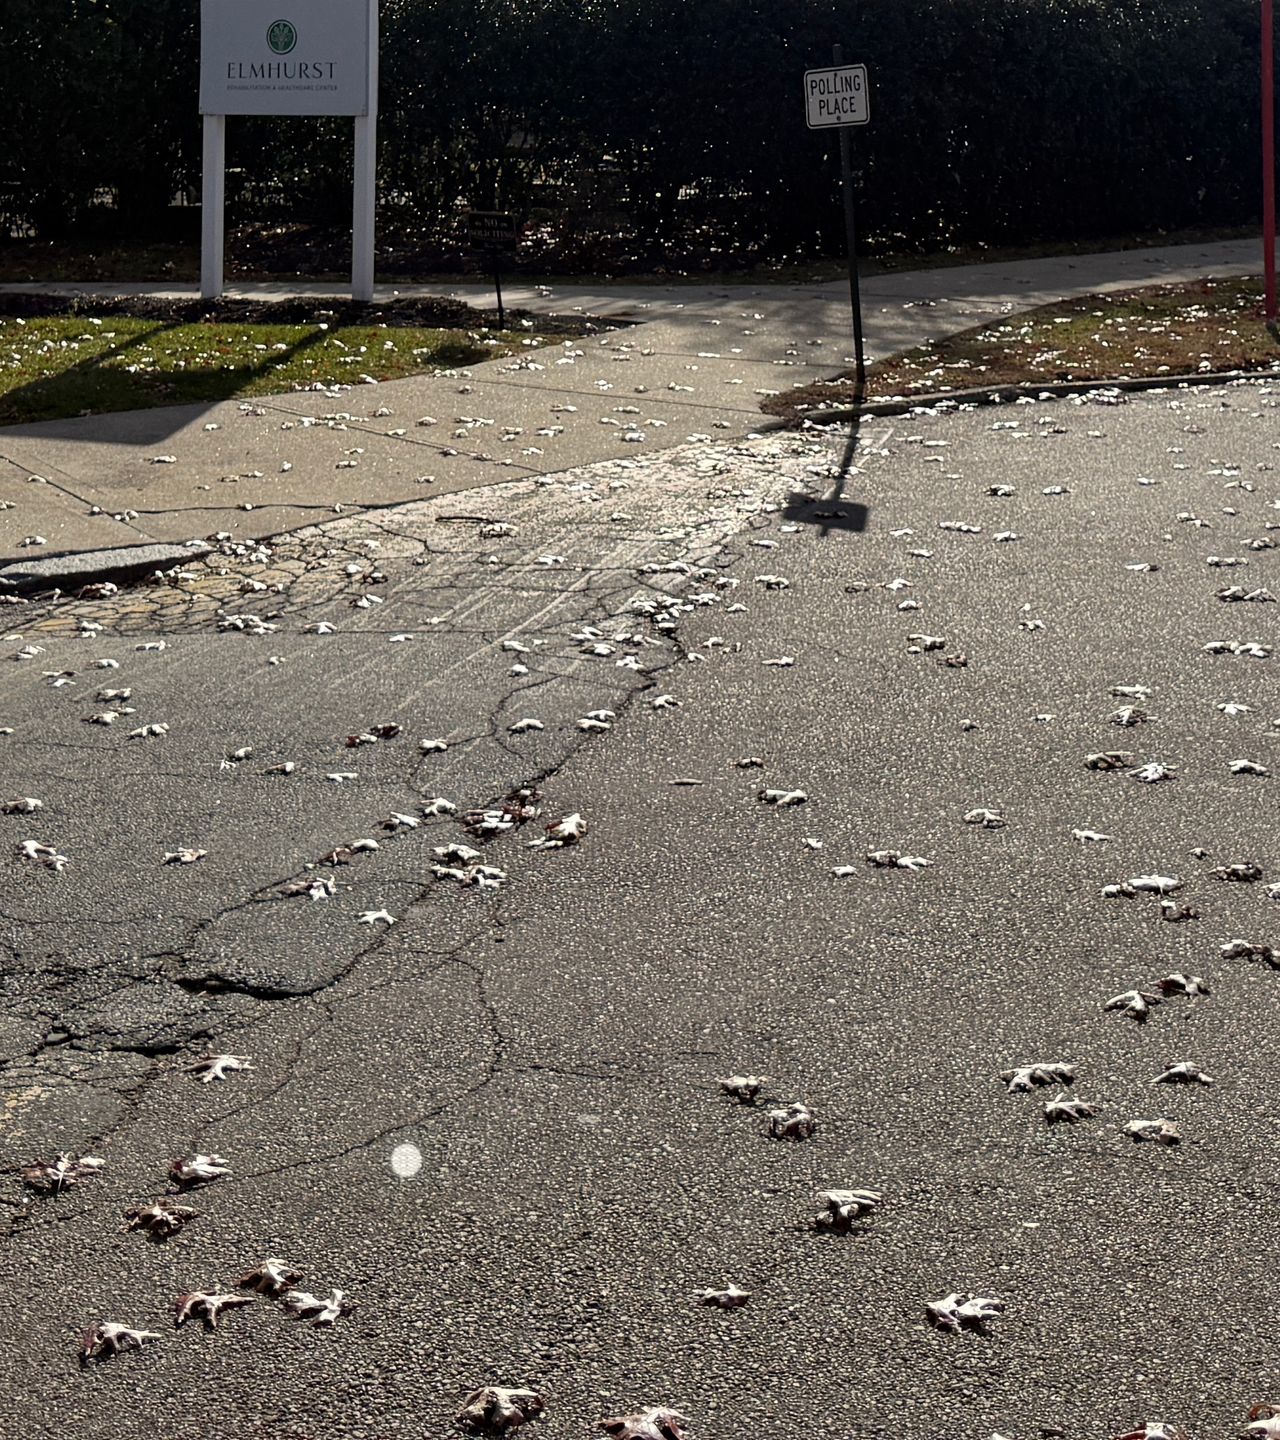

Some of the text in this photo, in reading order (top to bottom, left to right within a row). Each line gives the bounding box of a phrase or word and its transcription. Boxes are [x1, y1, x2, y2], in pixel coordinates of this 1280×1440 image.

[227, 61, 337, 79] ELMHURST
[810, 74, 861, 96] POLLING
[818, 96, 857, 117] PLACE
